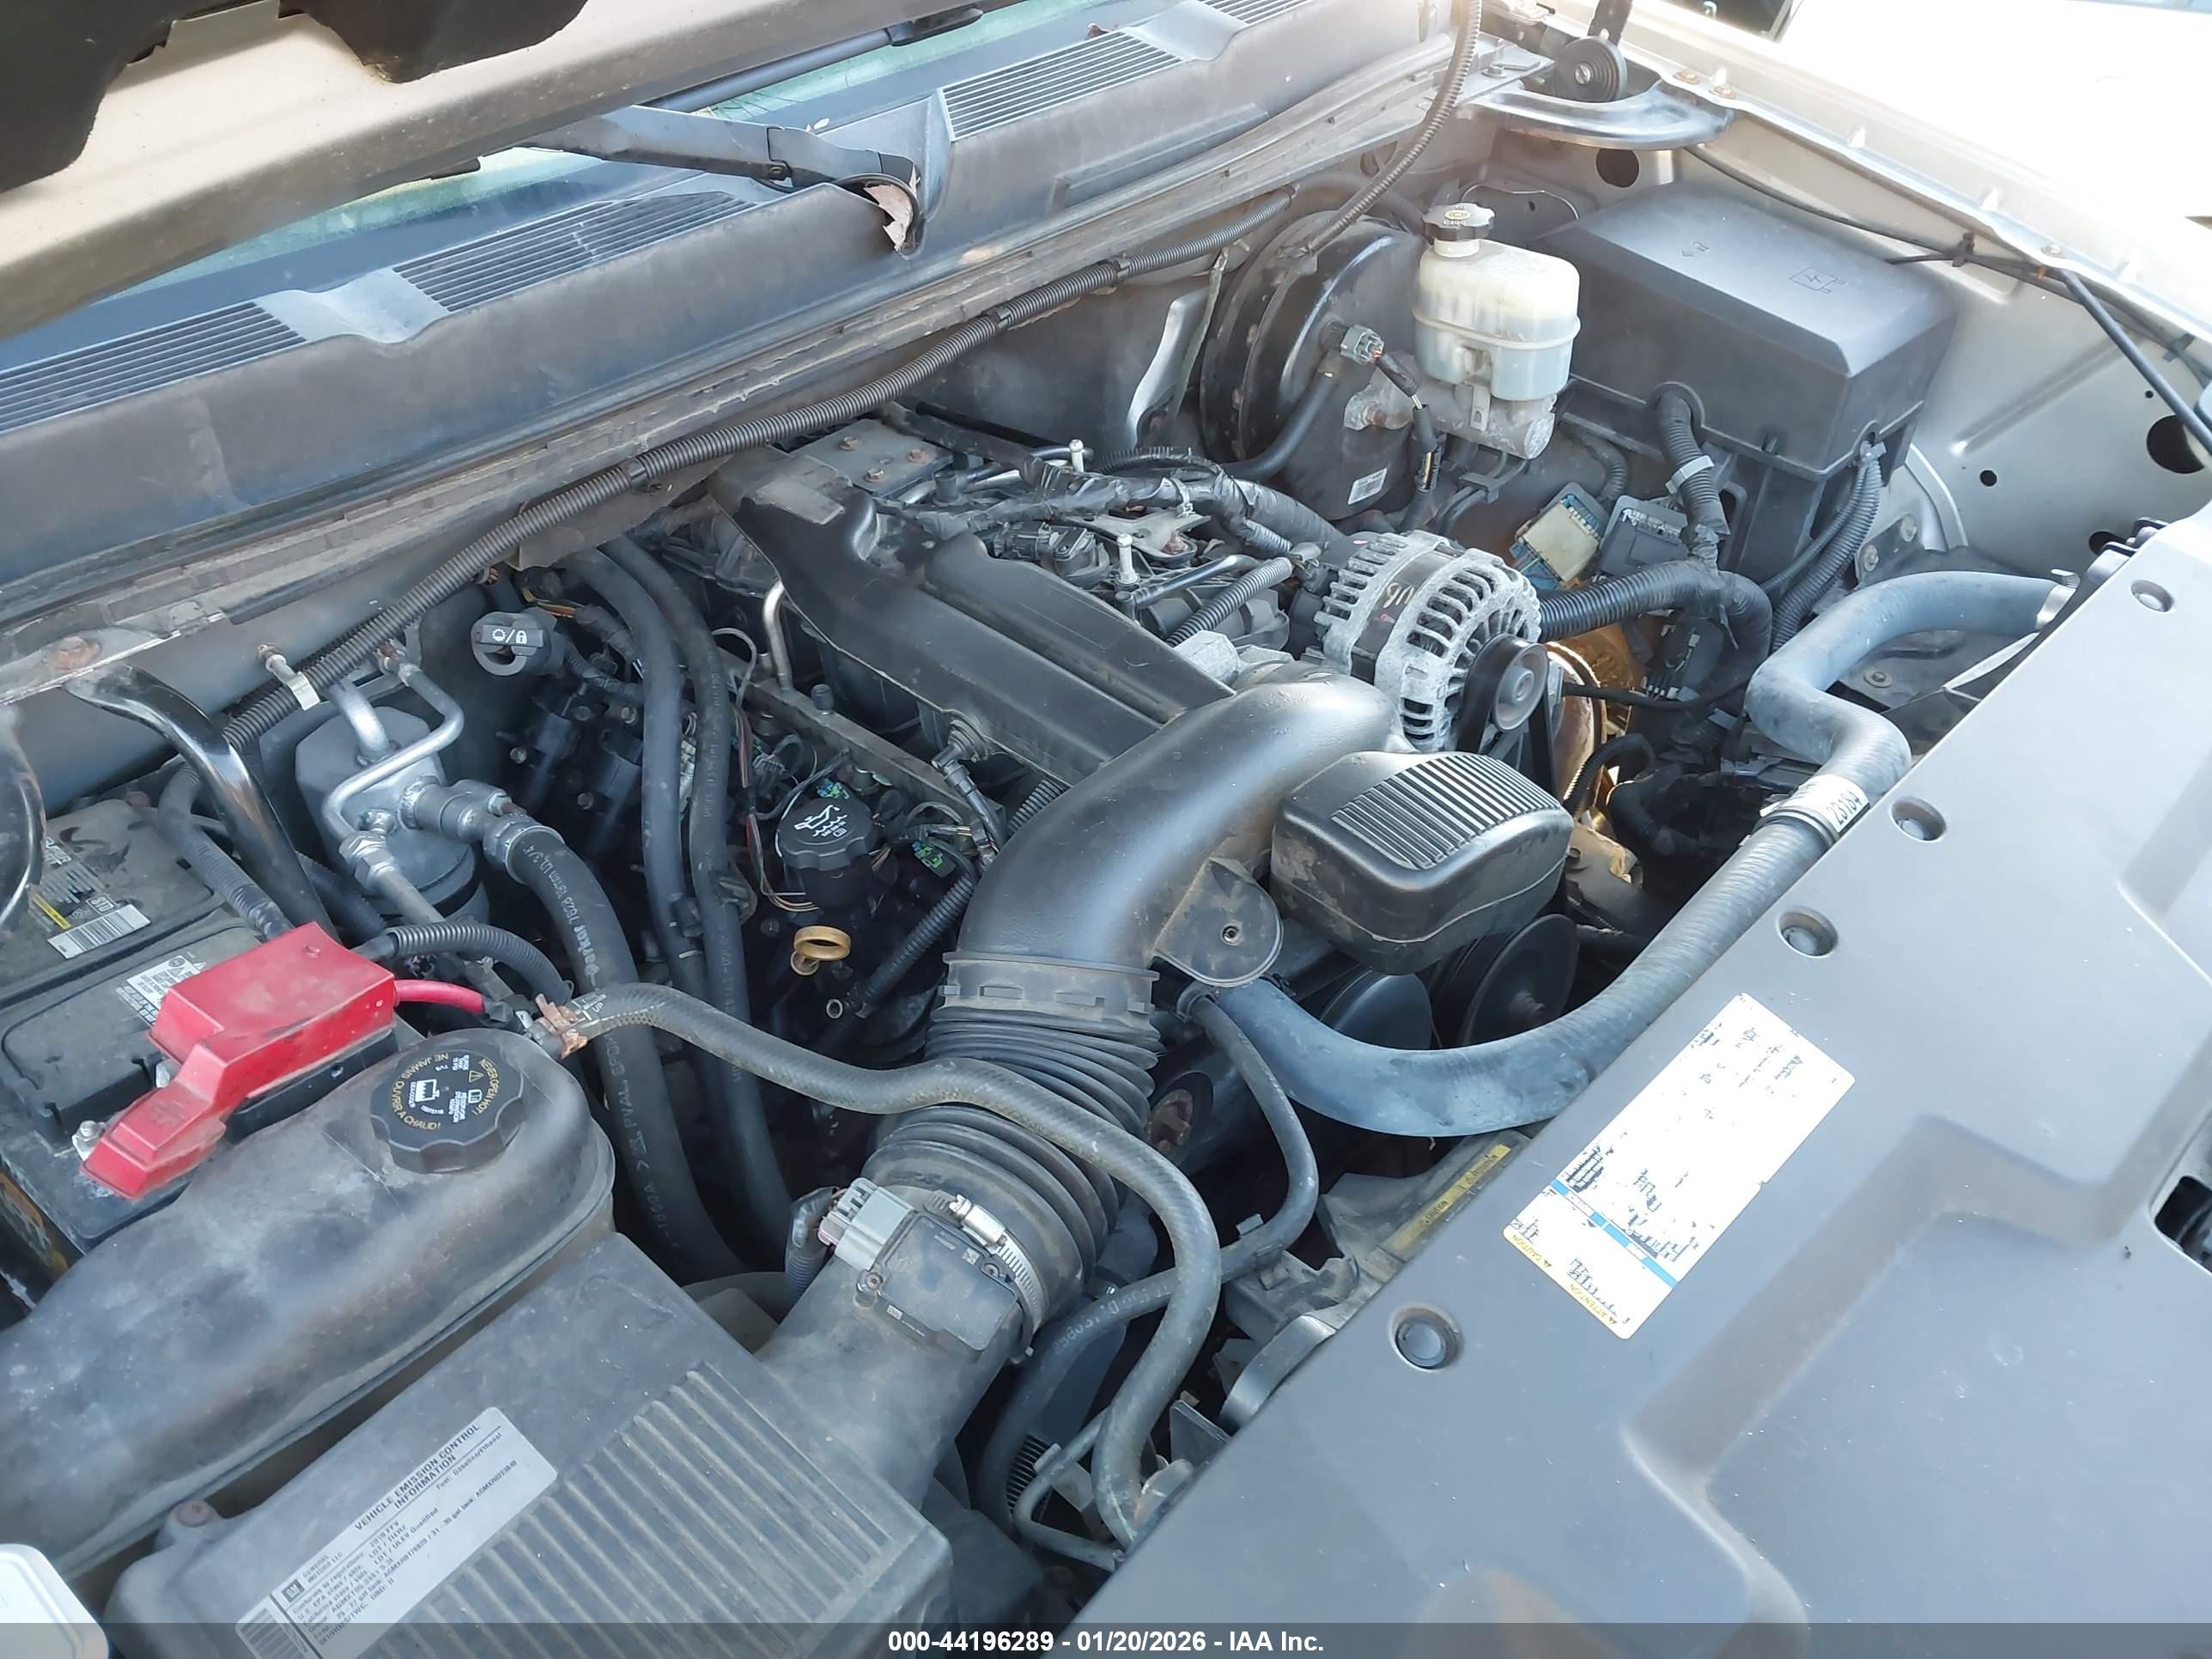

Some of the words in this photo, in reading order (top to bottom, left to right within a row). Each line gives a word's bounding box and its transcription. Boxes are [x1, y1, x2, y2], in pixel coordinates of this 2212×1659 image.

[592, 1002, 604, 1013] UP
[402, 1056, 433, 1079] JAMAIS
[434, 1053, 449, 1062] NE
[480, 1058, 499, 1079] NEVER
[391, 1080, 405, 1112] OUVRIR
[488, 1079, 501, 1102] OPEN
[353, 1494, 394, 1532] VEHICLE
[392, 1456, 439, 1498] EMISSION
[437, 1421, 480, 1460] CONTROL
[392, 1452, 457, 1510] INFORMATION
